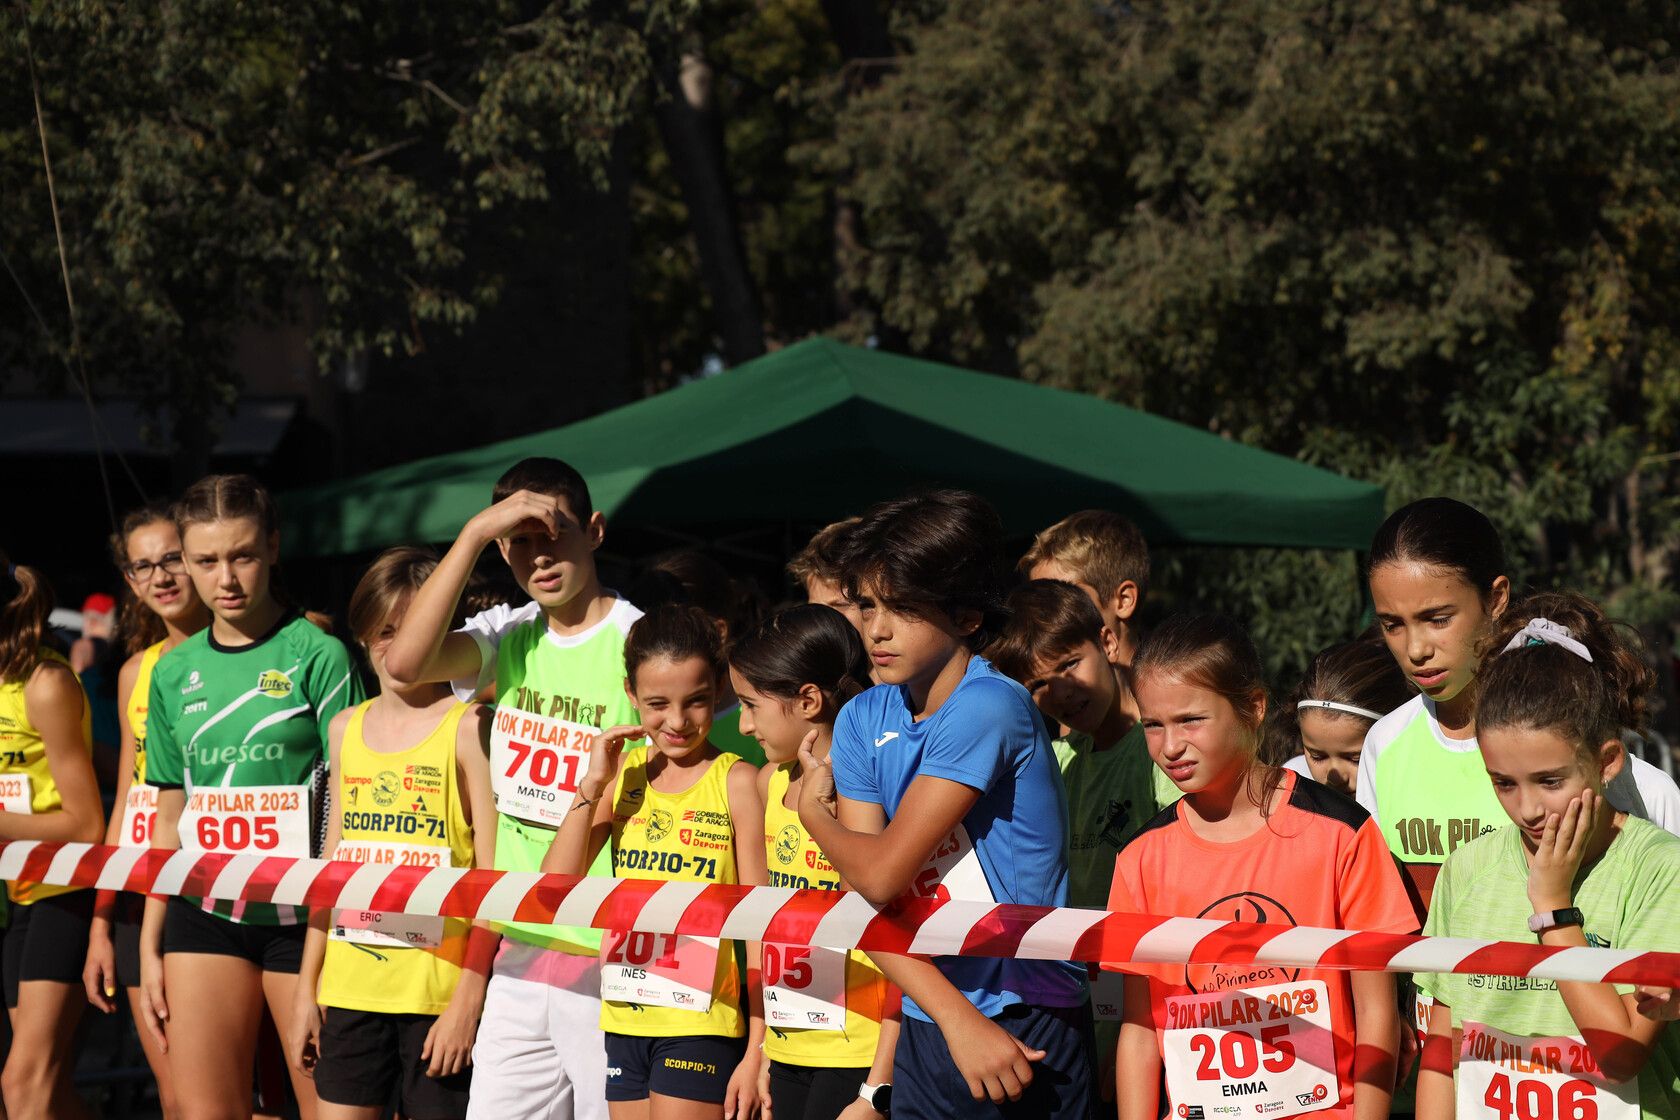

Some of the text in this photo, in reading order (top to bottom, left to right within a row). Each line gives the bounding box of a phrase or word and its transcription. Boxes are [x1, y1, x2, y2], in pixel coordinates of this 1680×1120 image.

[259, 673, 292, 691] intec
[495, 710, 518, 736] 10K
[521, 719, 569, 748] PILAR
[182, 742, 285, 767] Huesca
[505, 740, 580, 794] 701
[208, 794, 255, 812] PILAR
[260, 792, 299, 811] 2023
[517, 785, 556, 803] MATEO
[344, 812, 445, 838] SCORPIO-71
[695, 810, 729, 820] GOBIERNO
[197, 816, 279, 850] 605
[695, 829, 730, 841] Zaragoza
[1395, 817, 1444, 855] 10k
[401, 850, 441, 867] 2023
[614, 848, 717, 879] SCORPIO-71
[360, 912, 382, 922] ERIC
[606, 926, 680, 969] 201
[621, 968, 647, 980] INES
[1200, 997, 1262, 1028] PILAR
[1266, 988, 1319, 1020] 2023
[1190, 1024, 1296, 1080] 205
[1468, 1029, 1497, 1064] 10K
[1500, 1040, 1564, 1075] PILAR
[664, 1058, 716, 1074] SCORPIO-71
[1222, 1081, 1268, 1097] EMMA
[1484, 1072, 1598, 1120] 406
